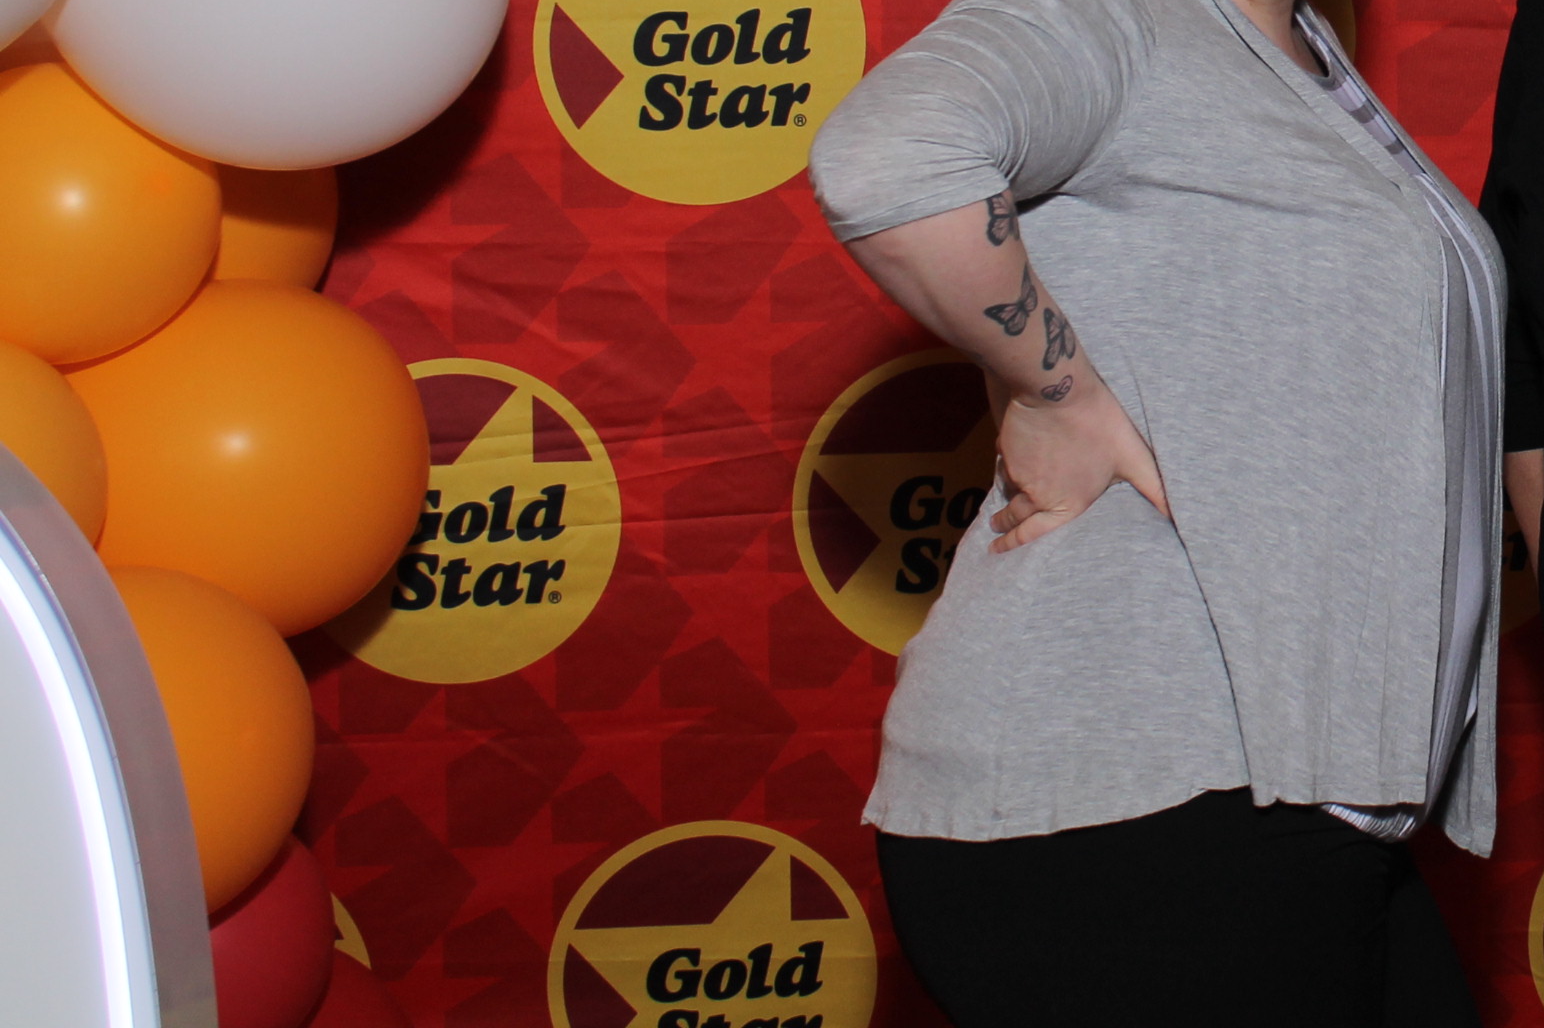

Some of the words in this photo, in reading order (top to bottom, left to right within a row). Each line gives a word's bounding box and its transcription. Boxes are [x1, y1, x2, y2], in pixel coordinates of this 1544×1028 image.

[633, 7, 812, 67] Gold
[889, 475, 987, 531] Go
[646, 941, 824, 1003] Gold
